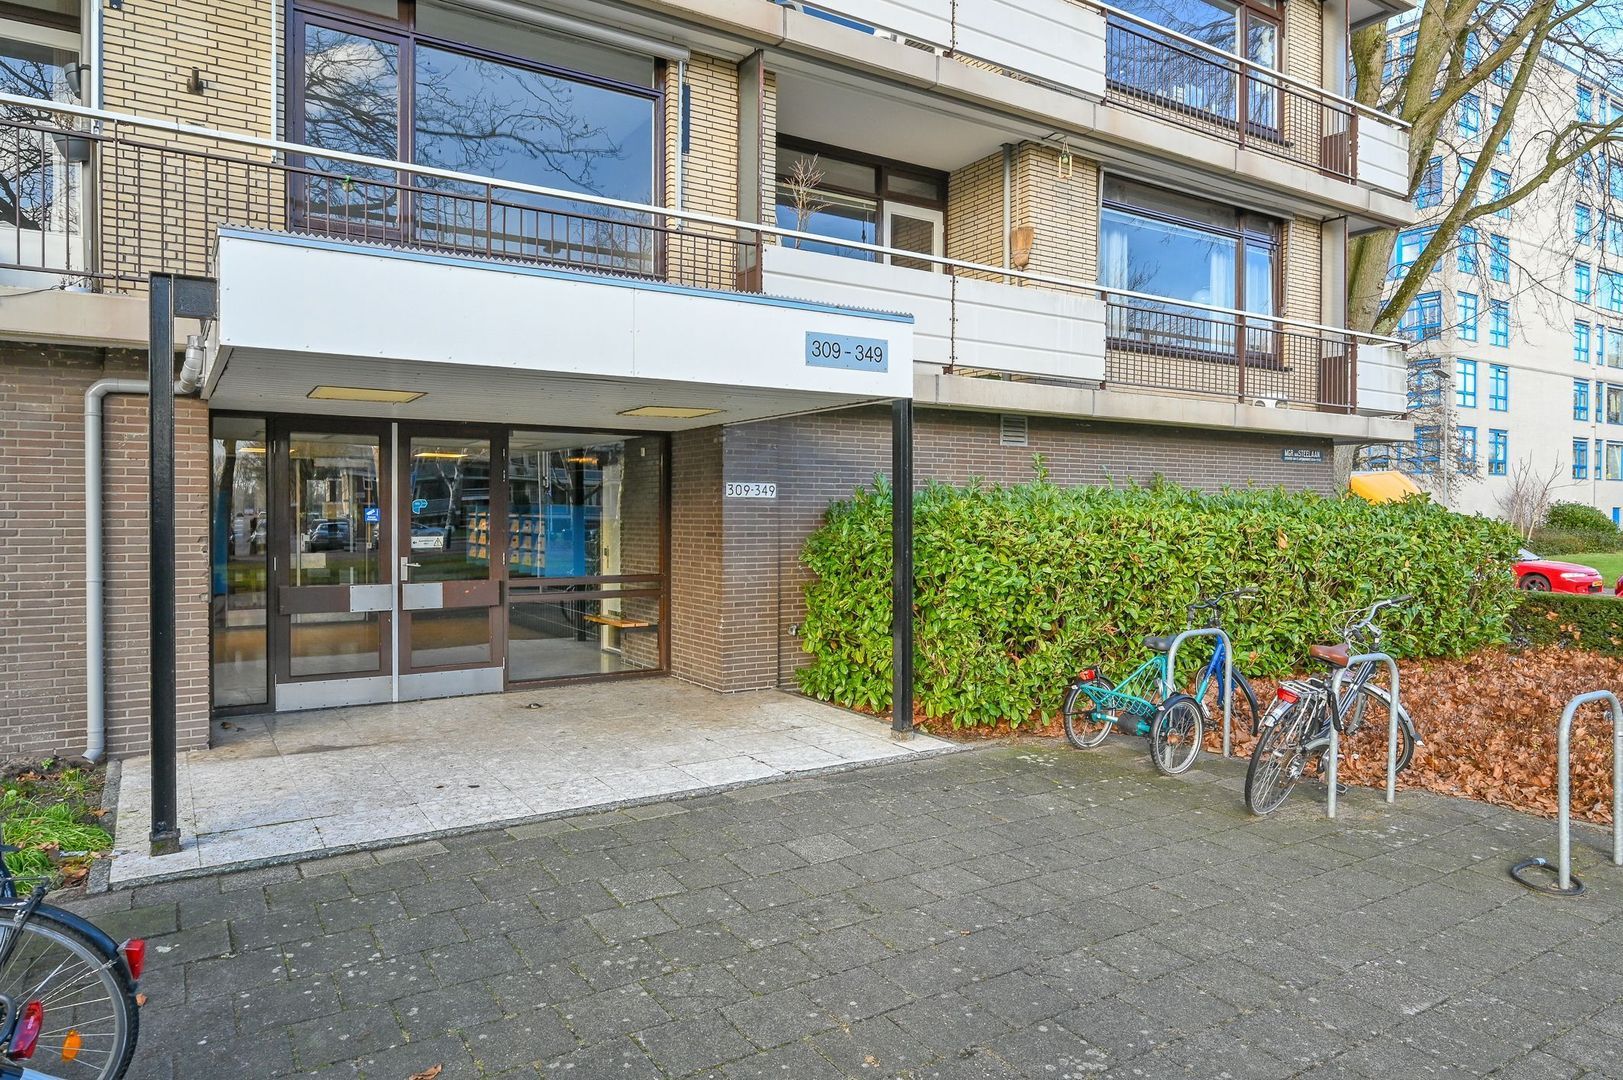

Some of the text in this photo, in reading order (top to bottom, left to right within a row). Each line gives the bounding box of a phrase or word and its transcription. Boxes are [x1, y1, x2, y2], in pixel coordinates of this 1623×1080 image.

[811, 340, 841, 359] 309
[855, 344, 883, 363] 349
[1284, 449, 1294, 457] MGR
[727, 483, 776, 497] 309-349
